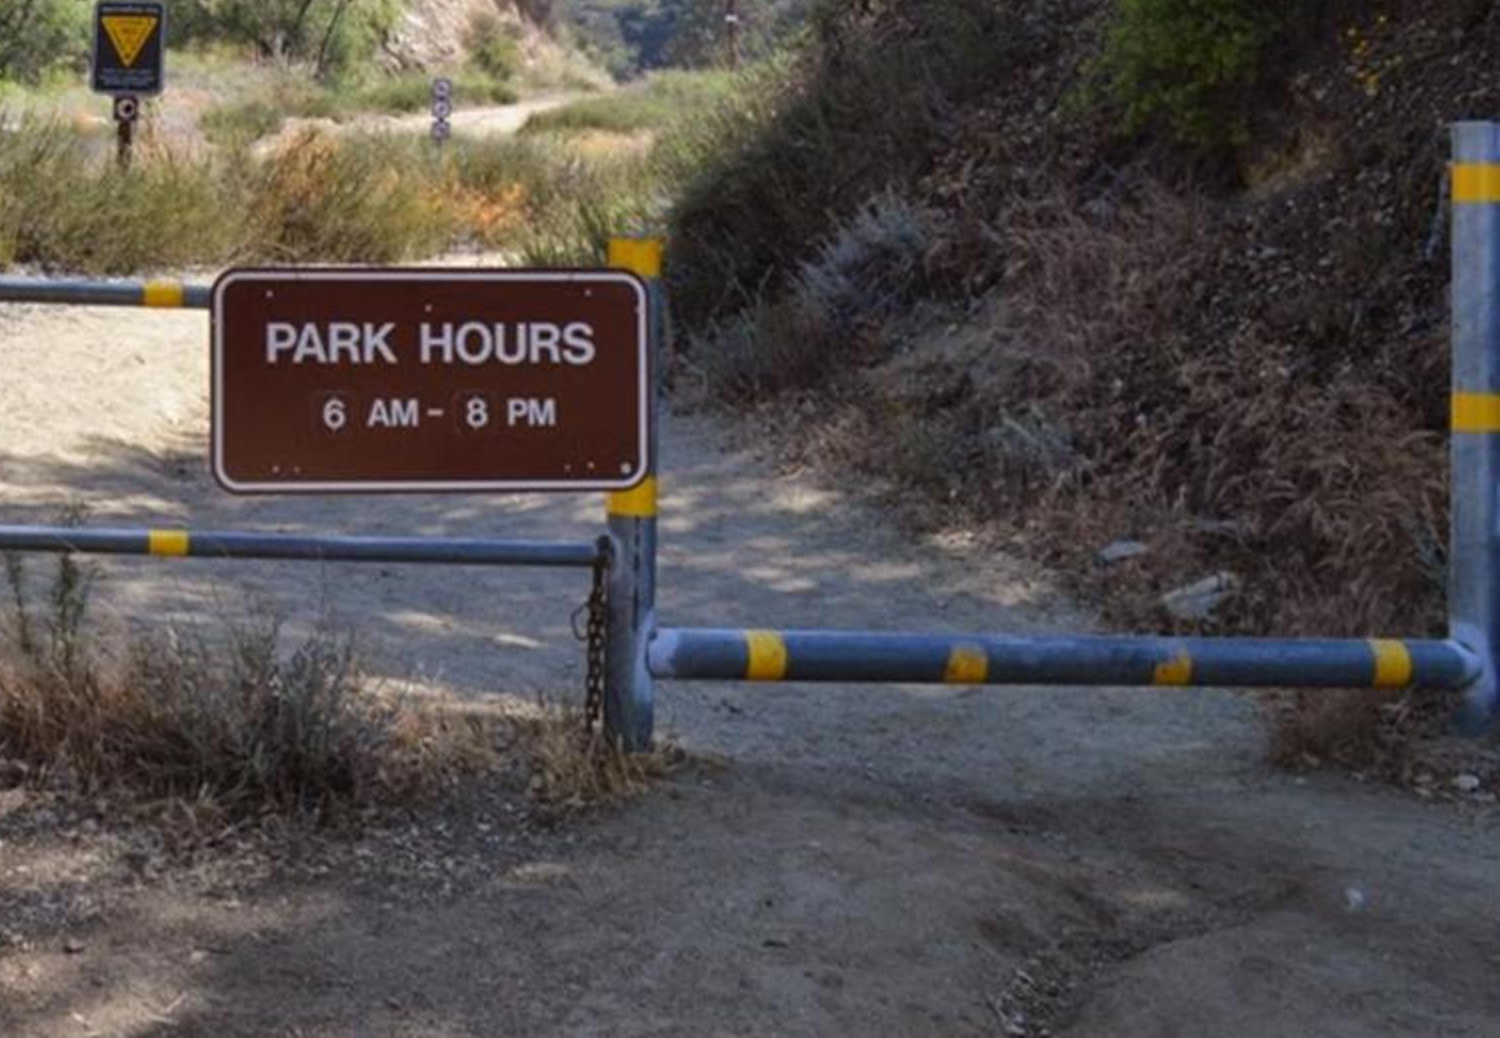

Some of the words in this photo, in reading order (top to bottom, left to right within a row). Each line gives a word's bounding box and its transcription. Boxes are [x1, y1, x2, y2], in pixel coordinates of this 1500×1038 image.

[266, 322, 398, 364] PARK
[420, 321, 596, 365] HOURS
[323, 398, 346, 429] 6
[465, 398, 489, 429] 8
[507, 398, 556, 427] PM
